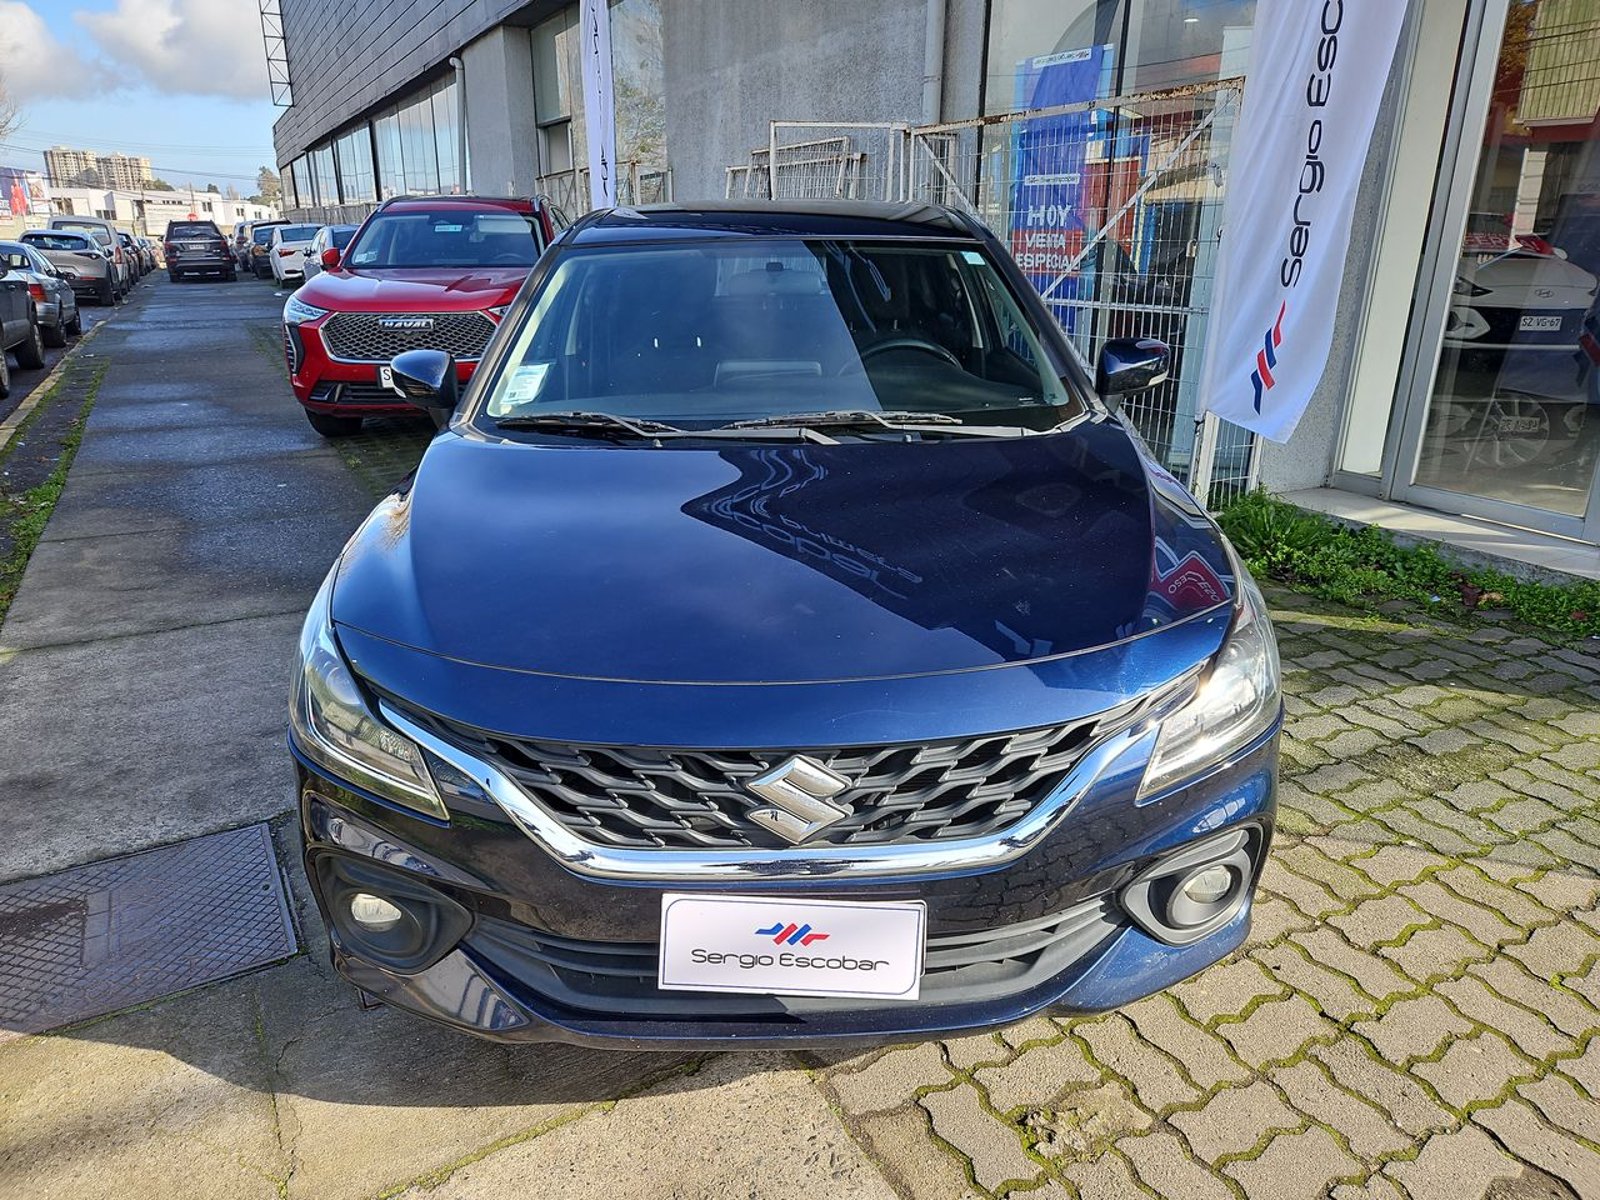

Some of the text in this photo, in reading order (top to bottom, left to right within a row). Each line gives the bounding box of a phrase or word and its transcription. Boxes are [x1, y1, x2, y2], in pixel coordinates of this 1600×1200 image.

[1280, 119, 1325, 288] Sergio
[1026, 204, 1072, 227] HOY
[690, 948, 891, 971] Sergio Escobar
